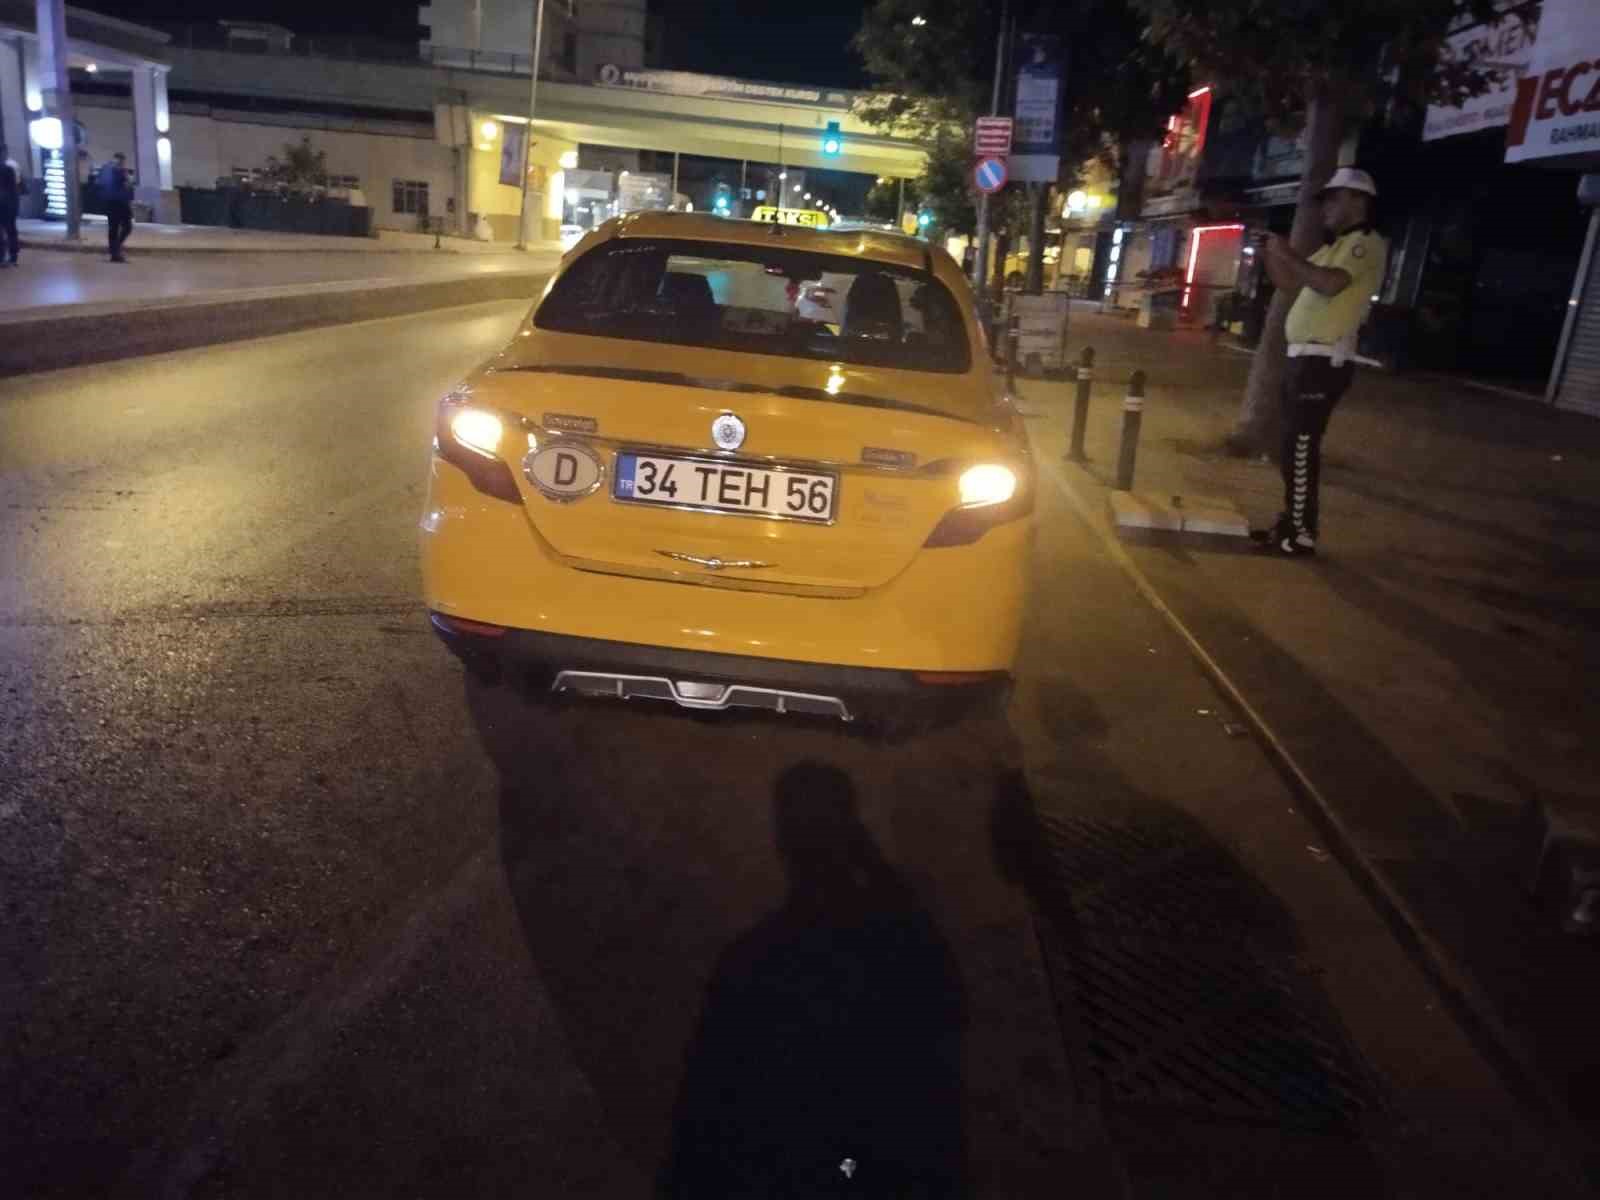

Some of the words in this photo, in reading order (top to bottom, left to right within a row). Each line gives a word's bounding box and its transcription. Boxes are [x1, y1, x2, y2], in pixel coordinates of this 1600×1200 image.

[554, 452, 578, 486] D
[636, 460, 678, 498] 34
[694, 466, 772, 508] TEH
[785, 476, 829, 514] 56
